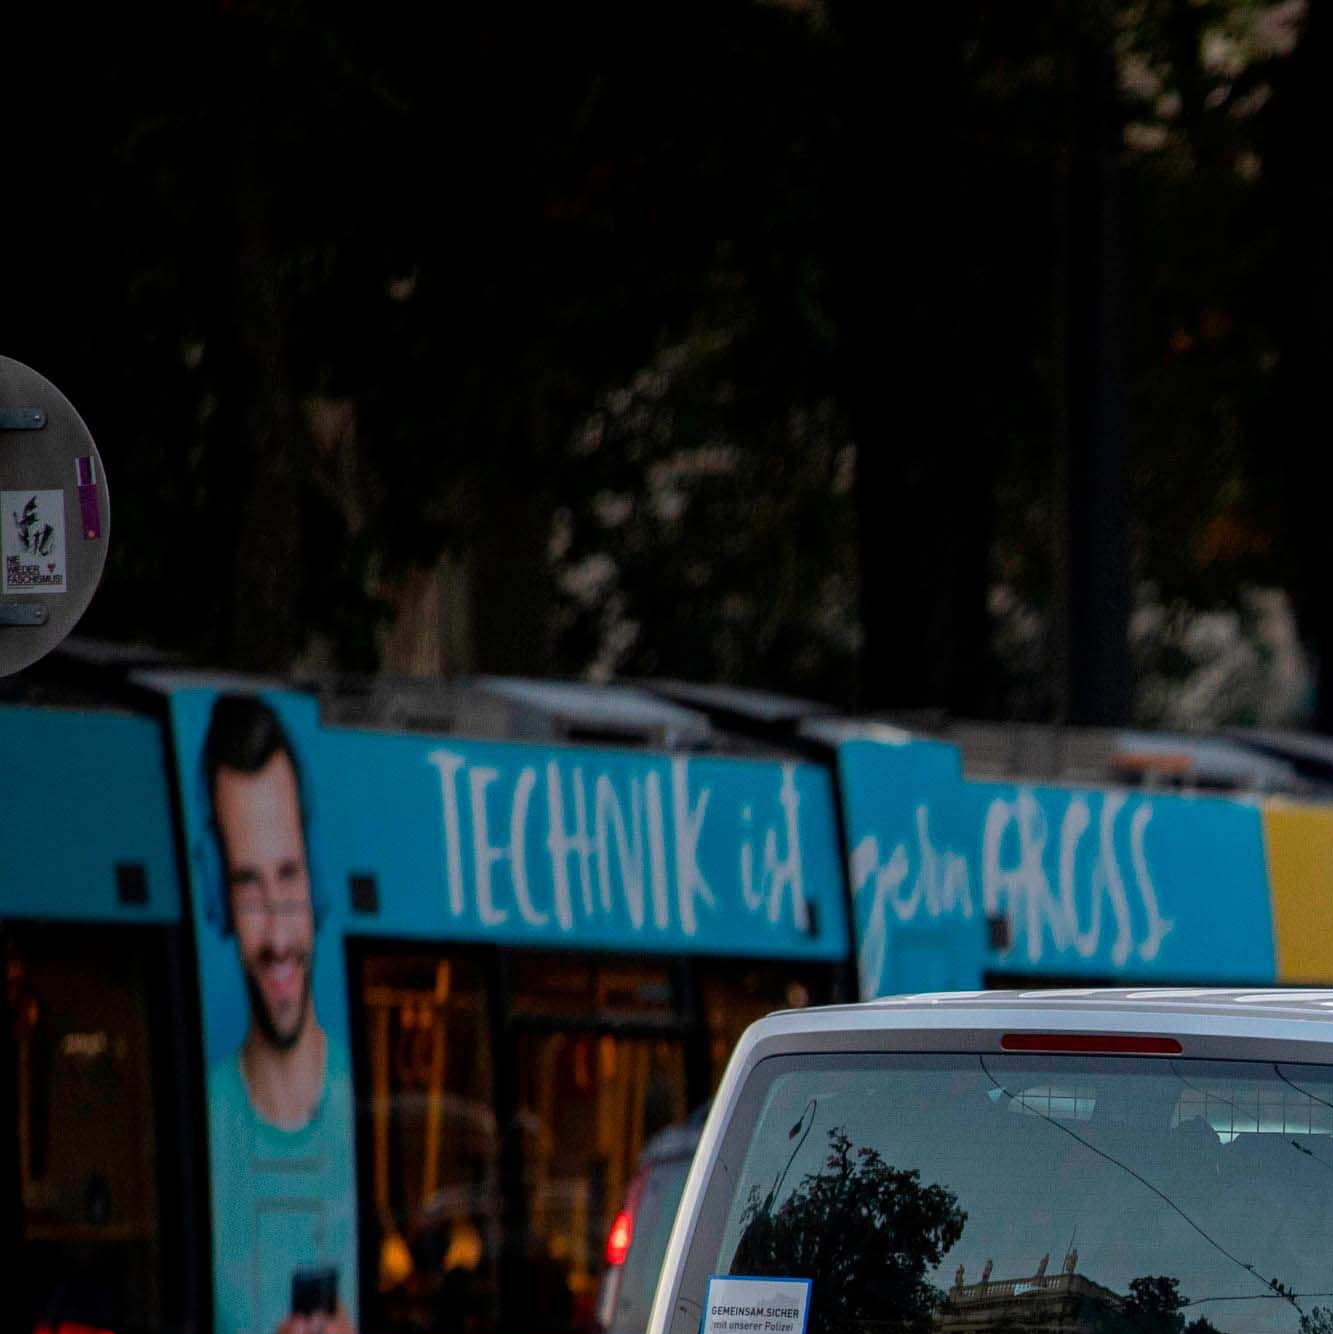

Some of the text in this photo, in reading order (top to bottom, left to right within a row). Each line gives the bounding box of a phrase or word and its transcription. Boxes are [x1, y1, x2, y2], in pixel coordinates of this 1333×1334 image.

[7, 555, 20, 564] NIE
[7, 565, 39, 575] WIEDER
[7, 575, 63, 584] FASCHISMUS!
[428, 749, 715, 936] TECHNIK
[984, 787, 1175, 969] GROSS
[713, 1321, 793, 1332] mit unserer Polizei
